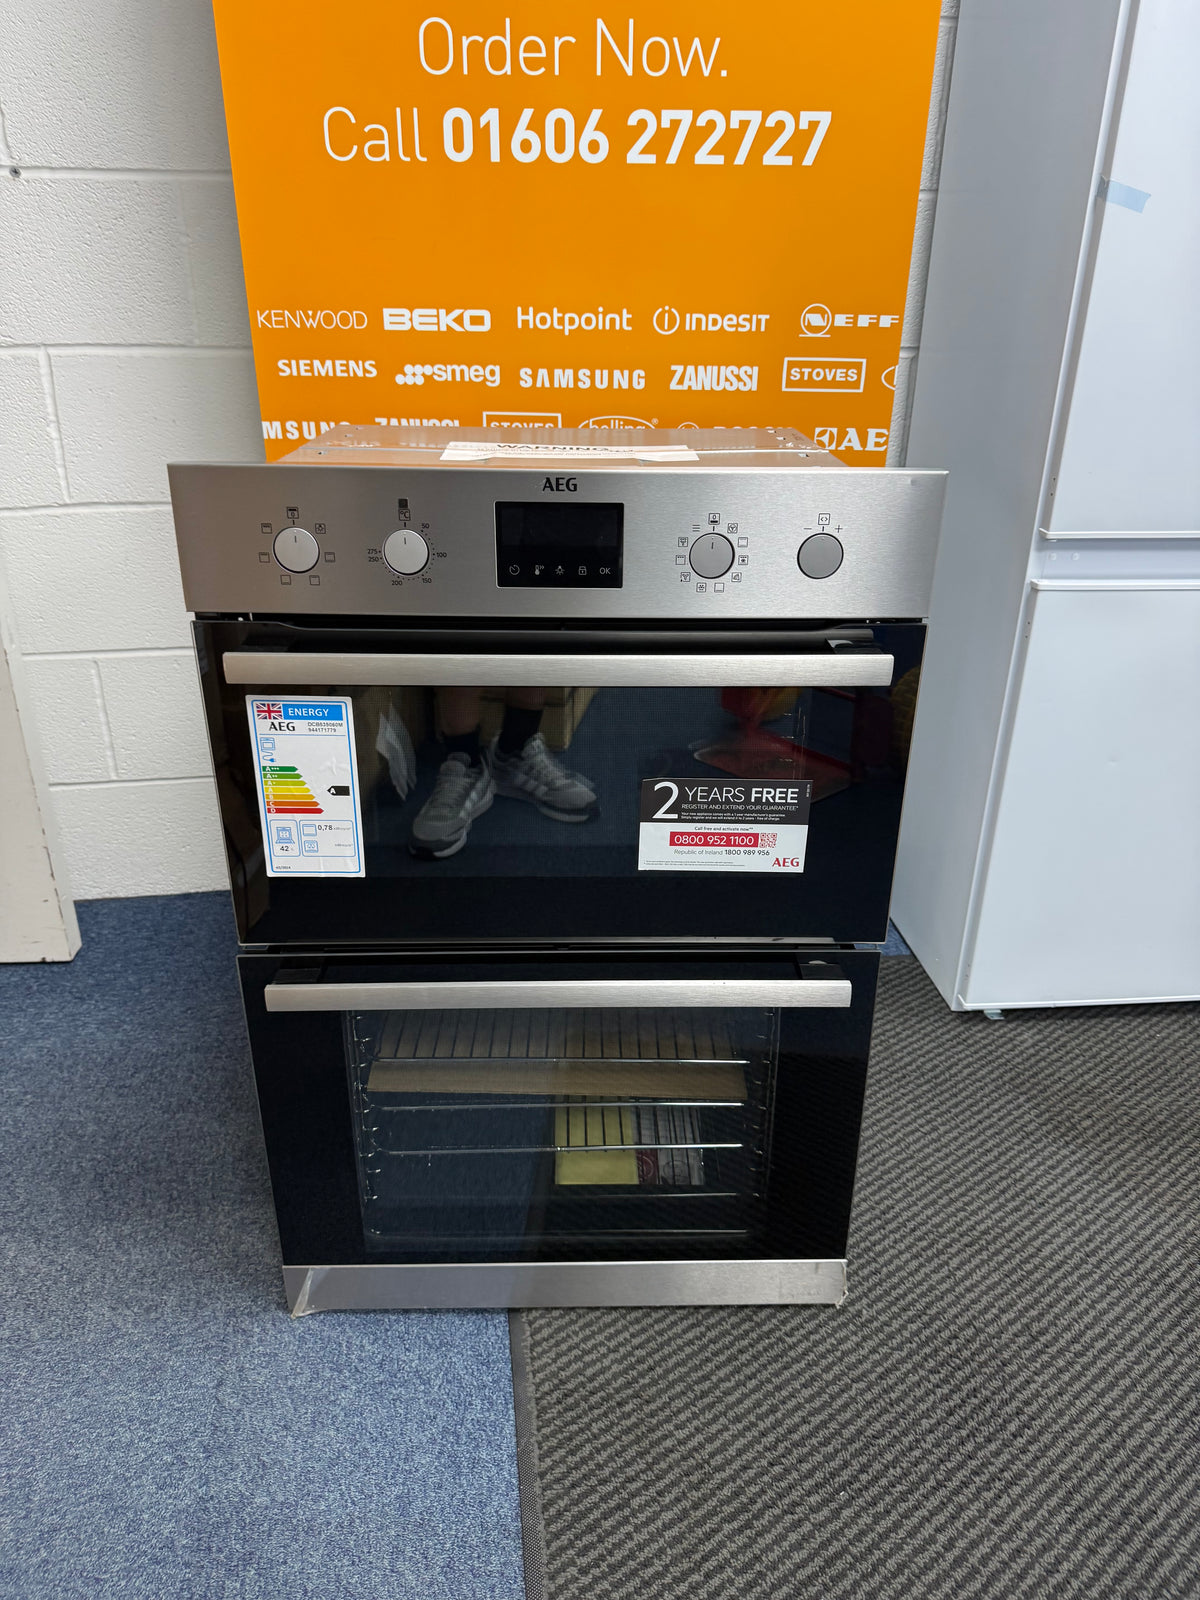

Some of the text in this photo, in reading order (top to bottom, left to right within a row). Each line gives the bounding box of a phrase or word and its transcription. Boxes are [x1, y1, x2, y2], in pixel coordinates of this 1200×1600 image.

[419, 17, 729, 78] Order Now.
[323, 106, 833, 167] Call 01606 272727
[256, 310, 368, 330] KENWOOD
[382, 308, 492, 332] BEKO
[516, 306, 633, 336] Hotpoint
[277, 359, 858, 391] SIEMENS smeg SAMSUNG ZANUSSI STOVES
[542, 476, 578, 492] AEG
[599, 567, 611, 575] OK
[288, 707, 329, 717] ENERGY
[269, 721, 296, 732] AEG
[651, 781, 679, 819] 2
[684, 786, 746, 803] YEARS
[750, 787, 799, 803] FREE
[674, 835, 754, 846] 0800 952 1100
[772, 857, 800, 867] AEG
